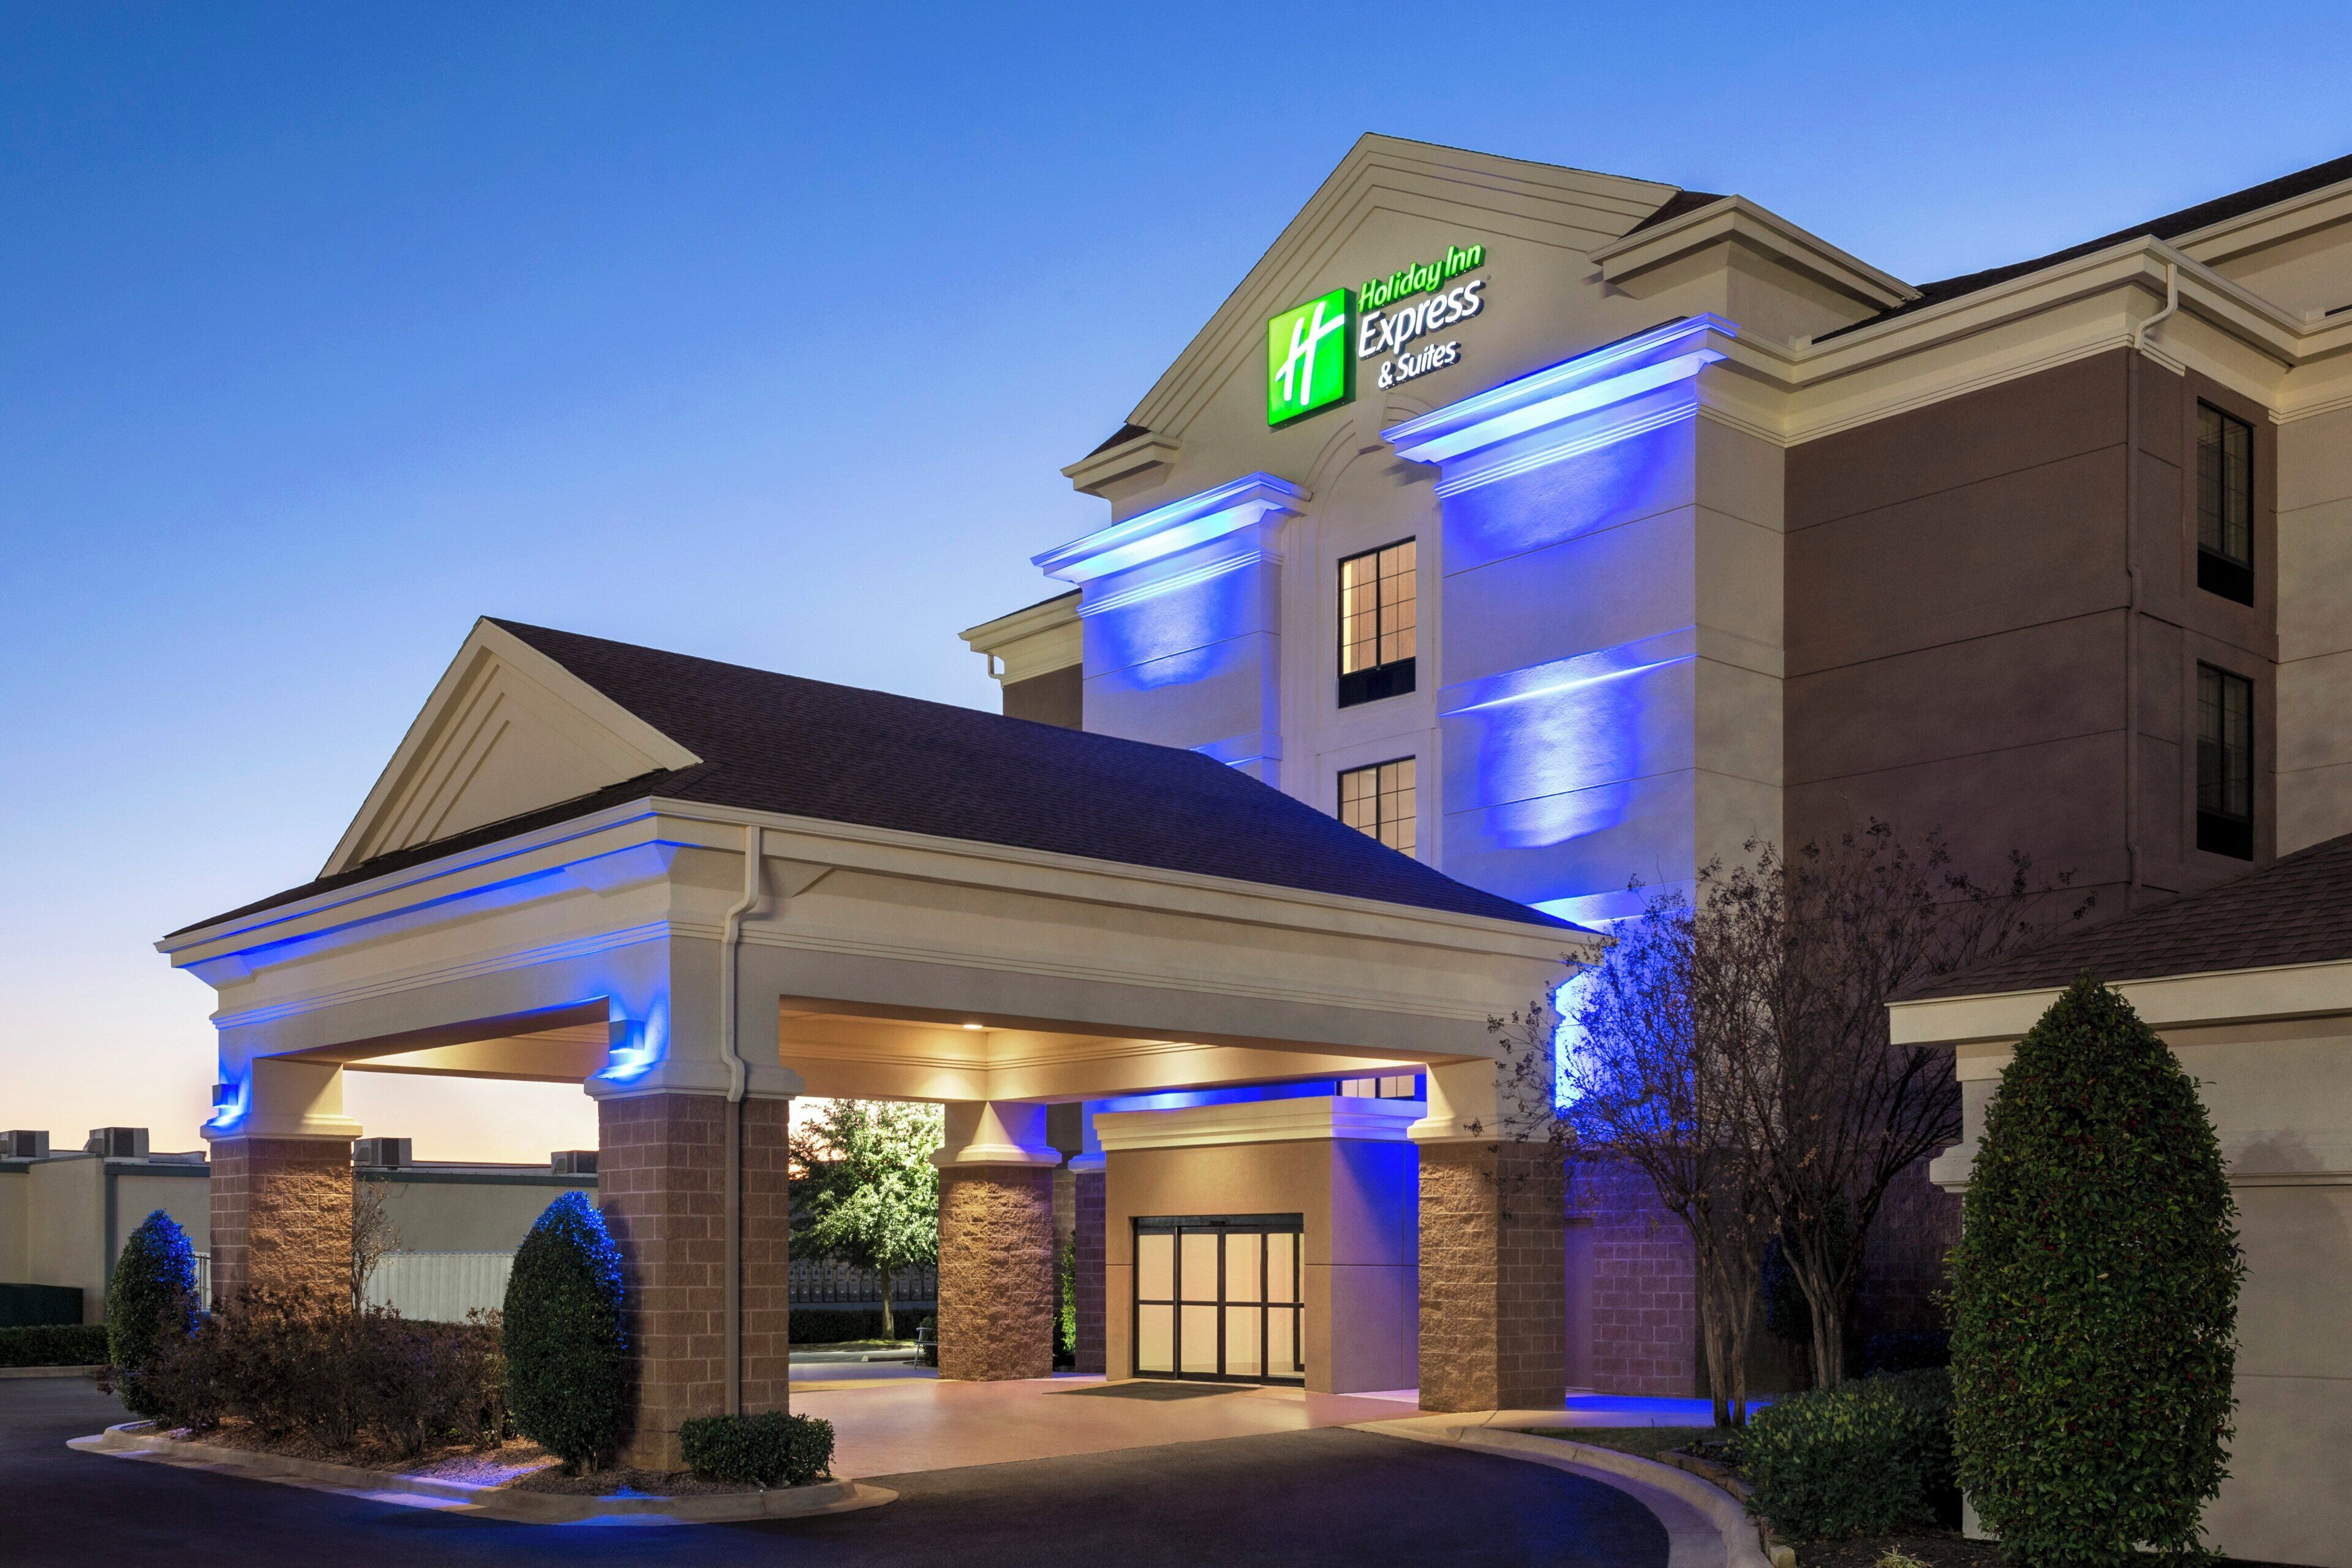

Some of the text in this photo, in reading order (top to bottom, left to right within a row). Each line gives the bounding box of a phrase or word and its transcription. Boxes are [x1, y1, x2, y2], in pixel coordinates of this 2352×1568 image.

[1358, 244, 1485, 313] Holiday Inn
[1275, 301, 1344, 405] H
[1358, 279, 1484, 358] Express
[1378, 341, 1459, 390] & Suites
